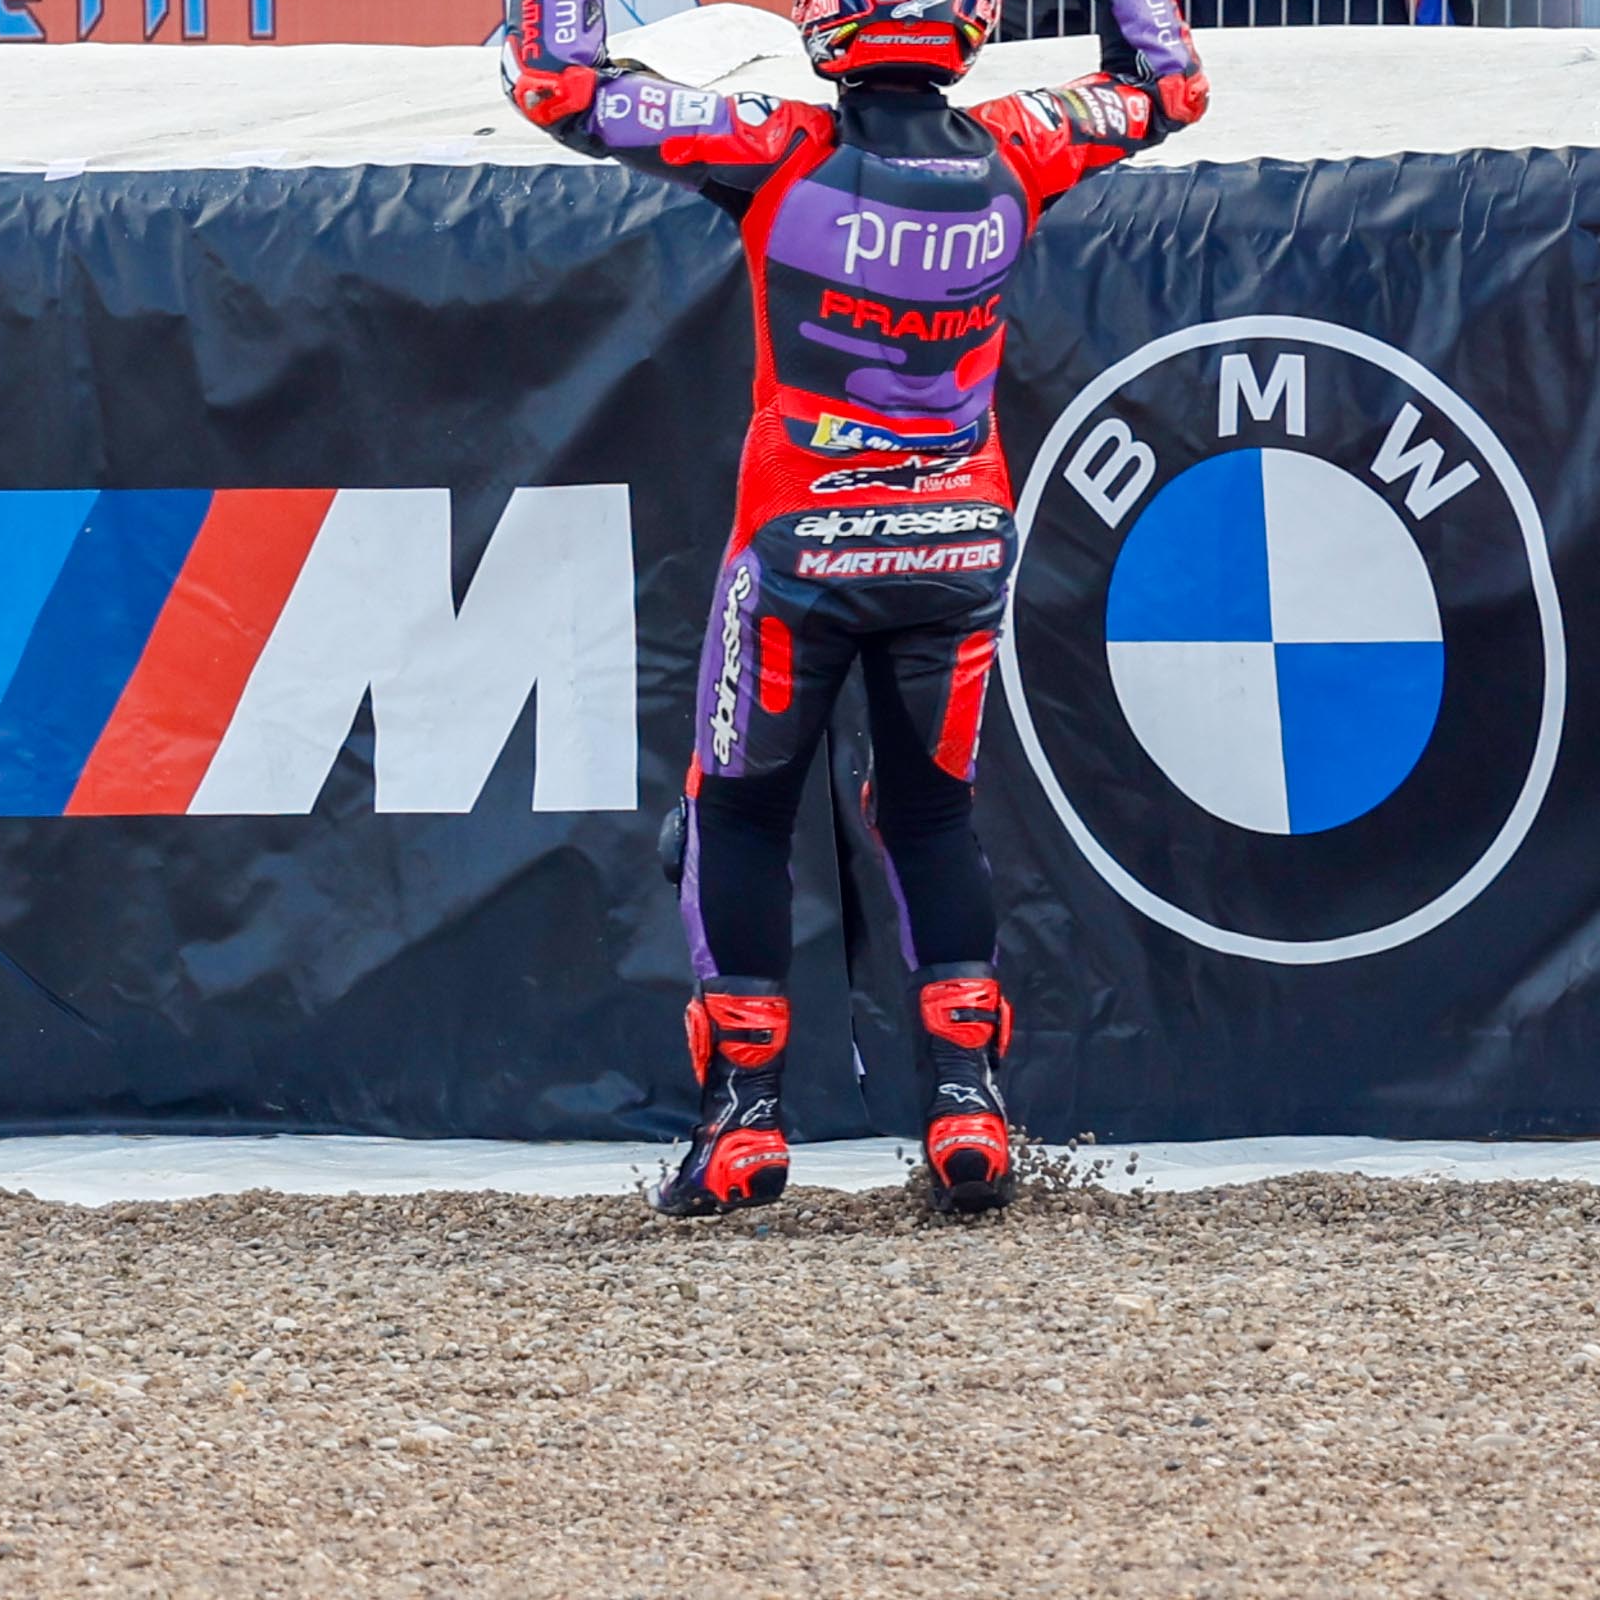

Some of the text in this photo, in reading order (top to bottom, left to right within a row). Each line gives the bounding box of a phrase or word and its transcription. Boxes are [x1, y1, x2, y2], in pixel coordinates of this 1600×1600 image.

[638, 85, 667, 132] 89
[836, 211, 1004, 274] prima
[820, 288, 1002, 342] PRAMAC
[1063, 353, 1480, 529] BMW
[794, 506, 1003, 544] alpinestars
[798, 542, 1002, 576] MARTINATOR
[710, 565, 752, 766] alpinestars
